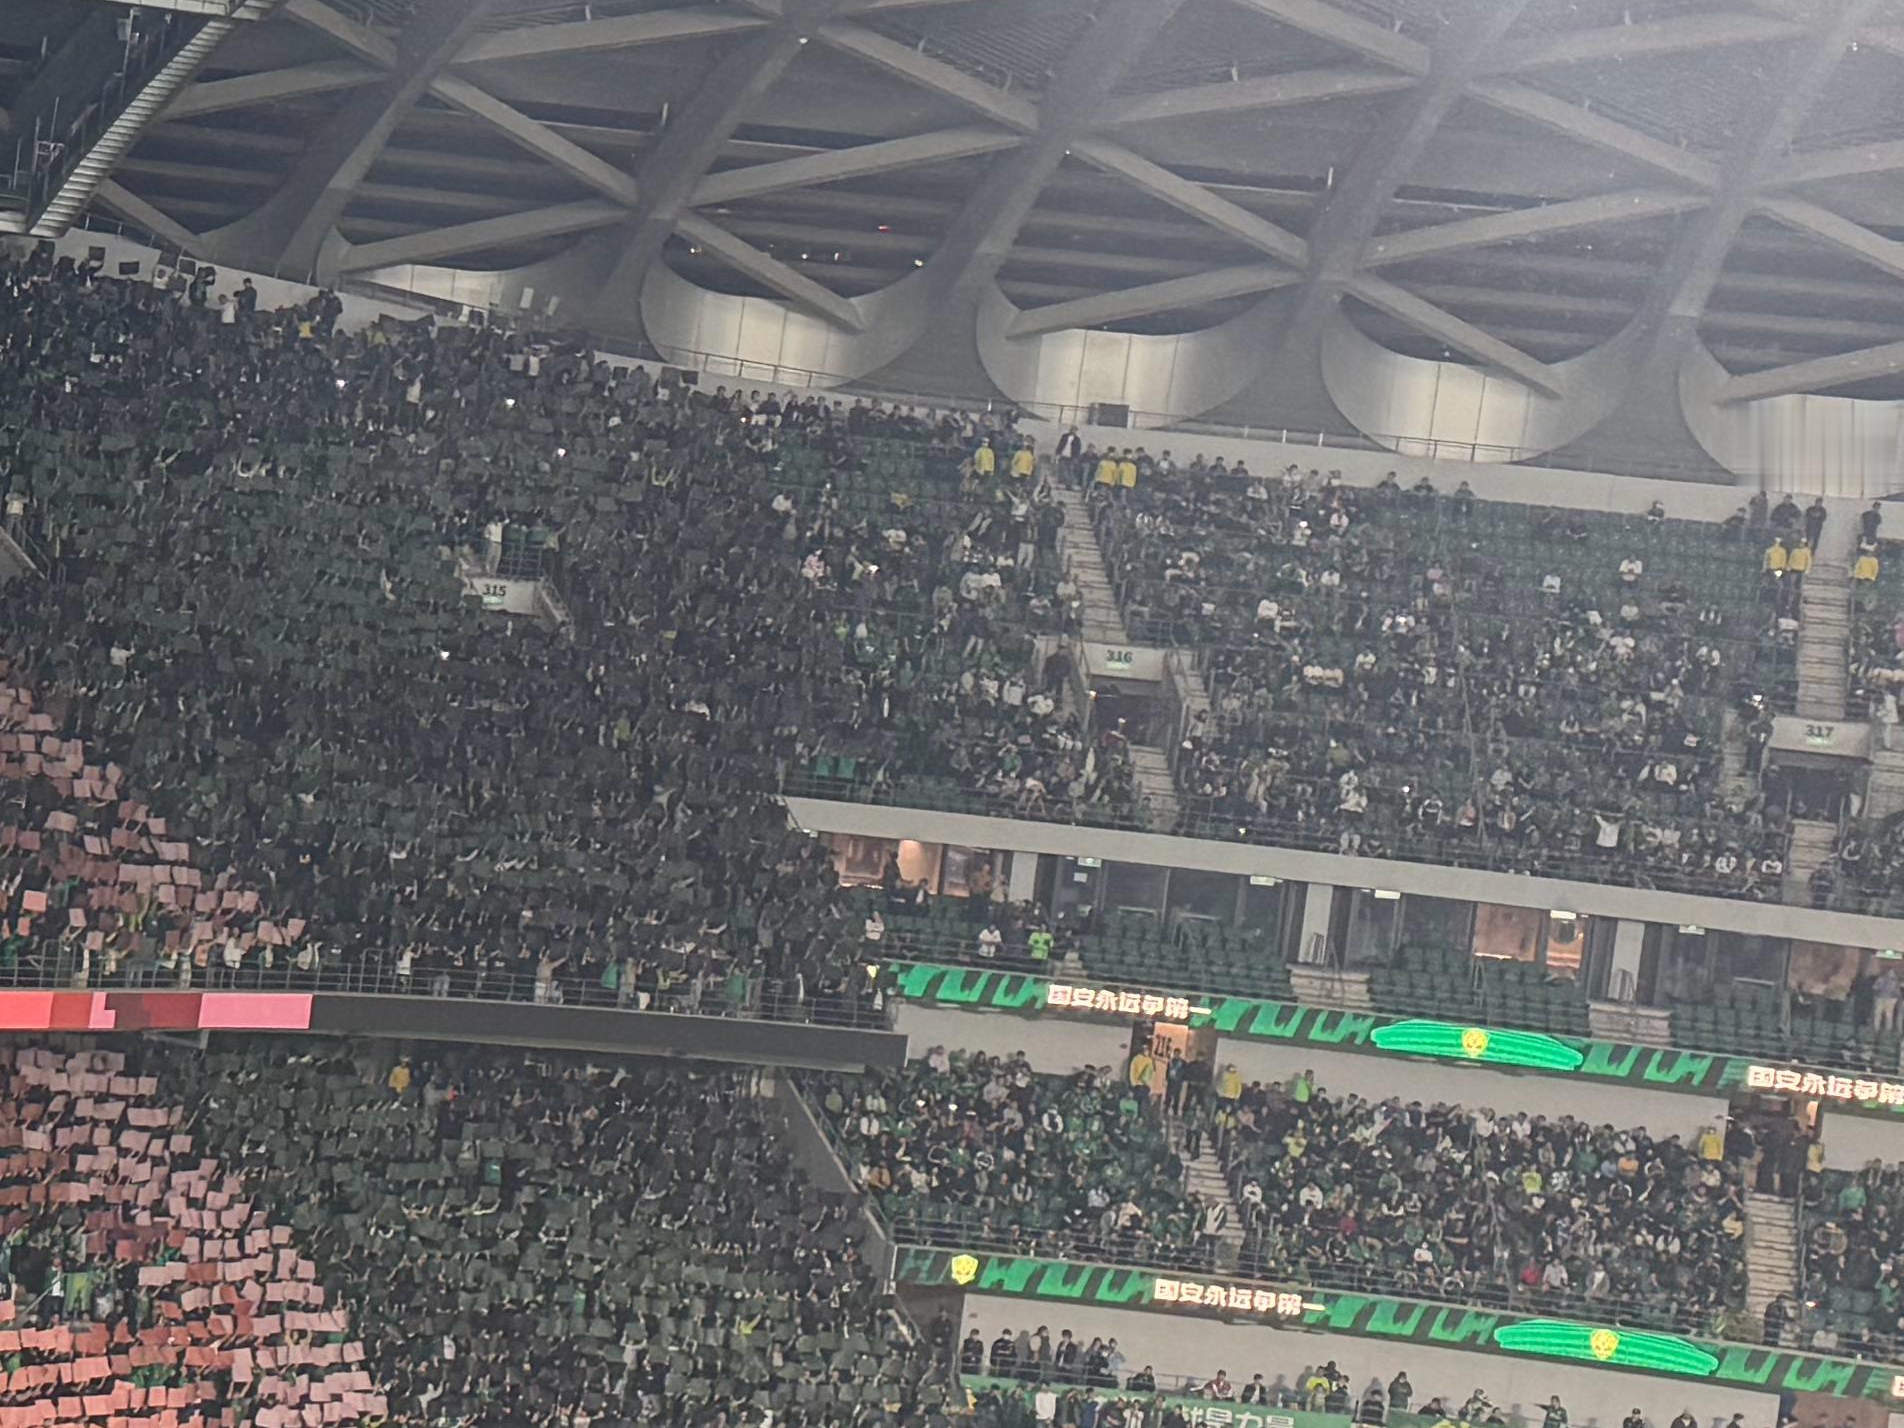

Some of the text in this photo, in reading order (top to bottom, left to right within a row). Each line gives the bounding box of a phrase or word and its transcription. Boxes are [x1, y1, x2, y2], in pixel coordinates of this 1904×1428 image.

[482, 584, 507, 598] 315
[1106, 649, 1133, 663] 316
[1805, 724, 1834, 738] 317
[1047, 984, 1212, 1019] 国安永远争第一
[1154, 1278, 1327, 1316] 国安永远争第一
